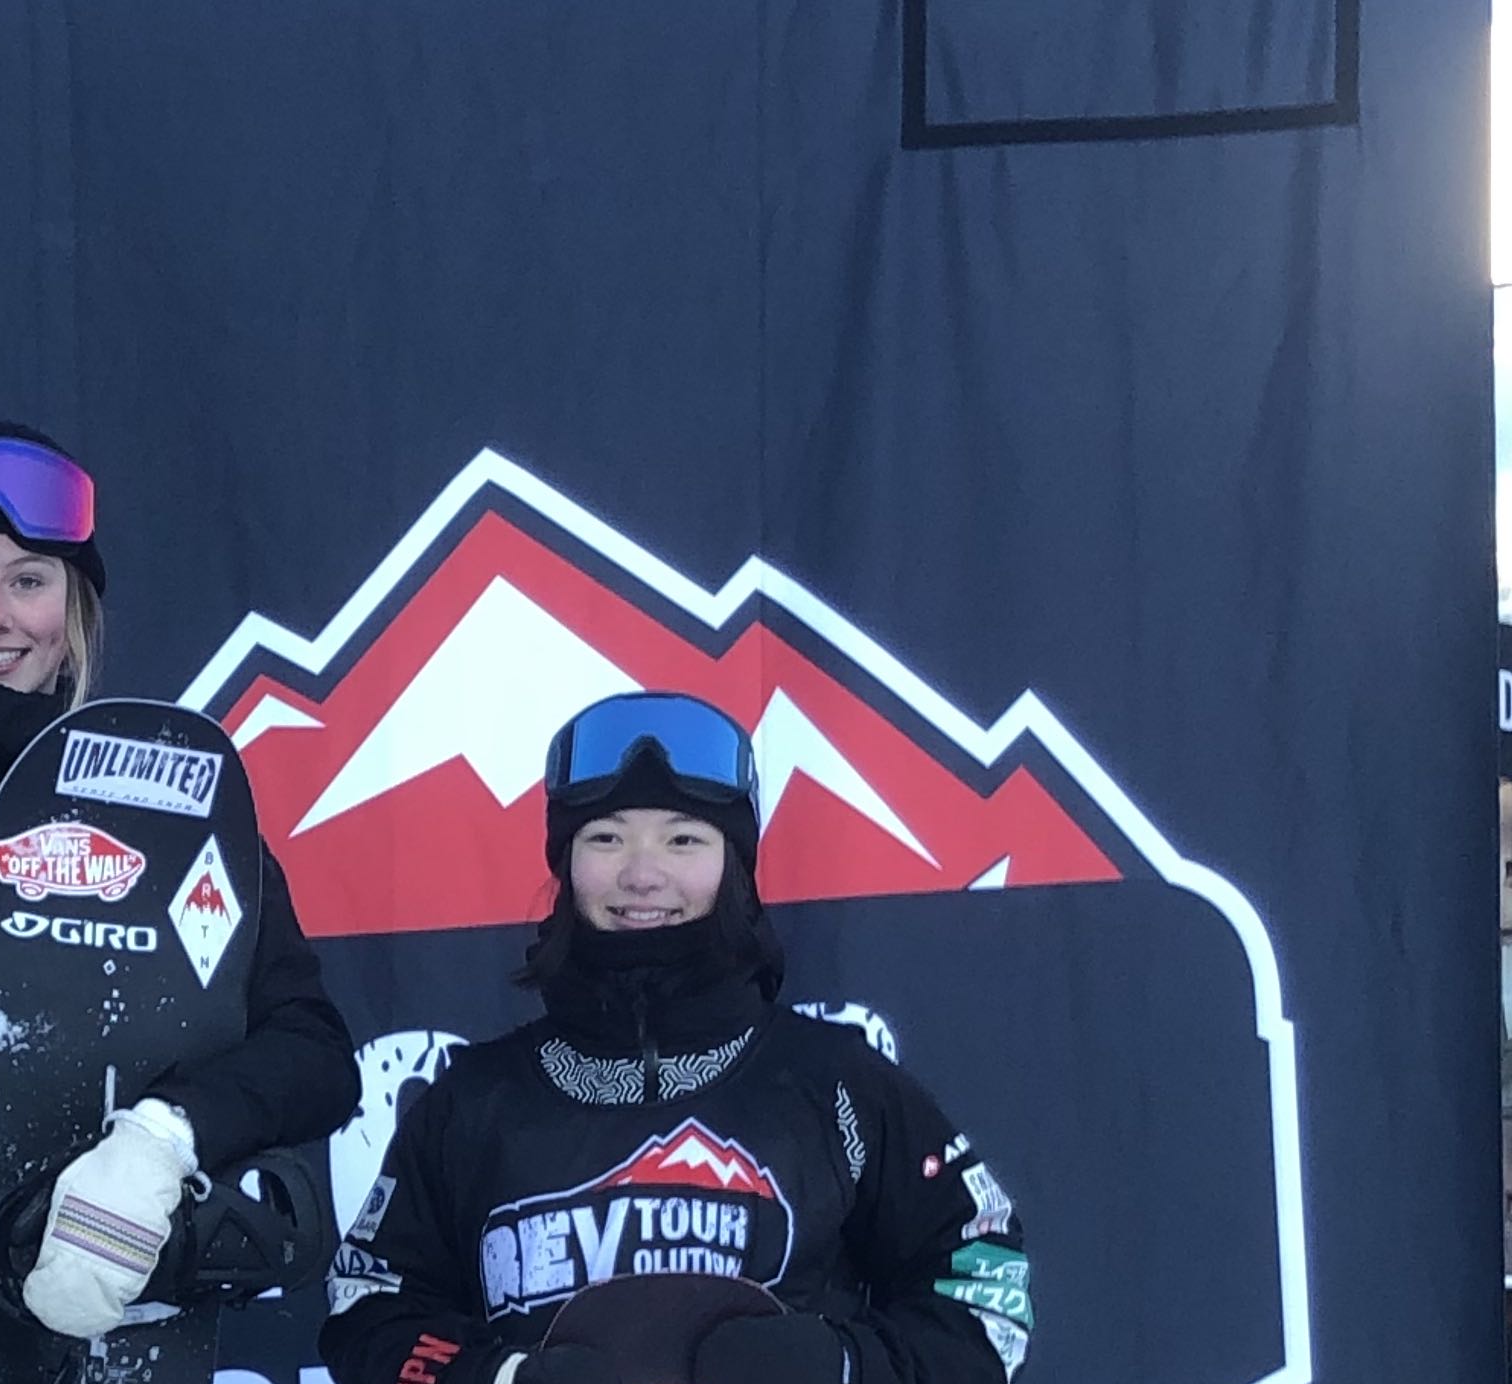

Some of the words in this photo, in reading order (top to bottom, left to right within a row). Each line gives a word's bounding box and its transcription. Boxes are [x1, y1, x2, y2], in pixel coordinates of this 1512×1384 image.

[63, 738, 216, 804] UNLIMITED
[40, 833, 92, 856] VANS
[45, 856, 82, 884] THE
[51, 916, 157, 952] GIRO
[482, 1197, 631, 1307] REV
[634, 1197, 749, 1250] TOUR
